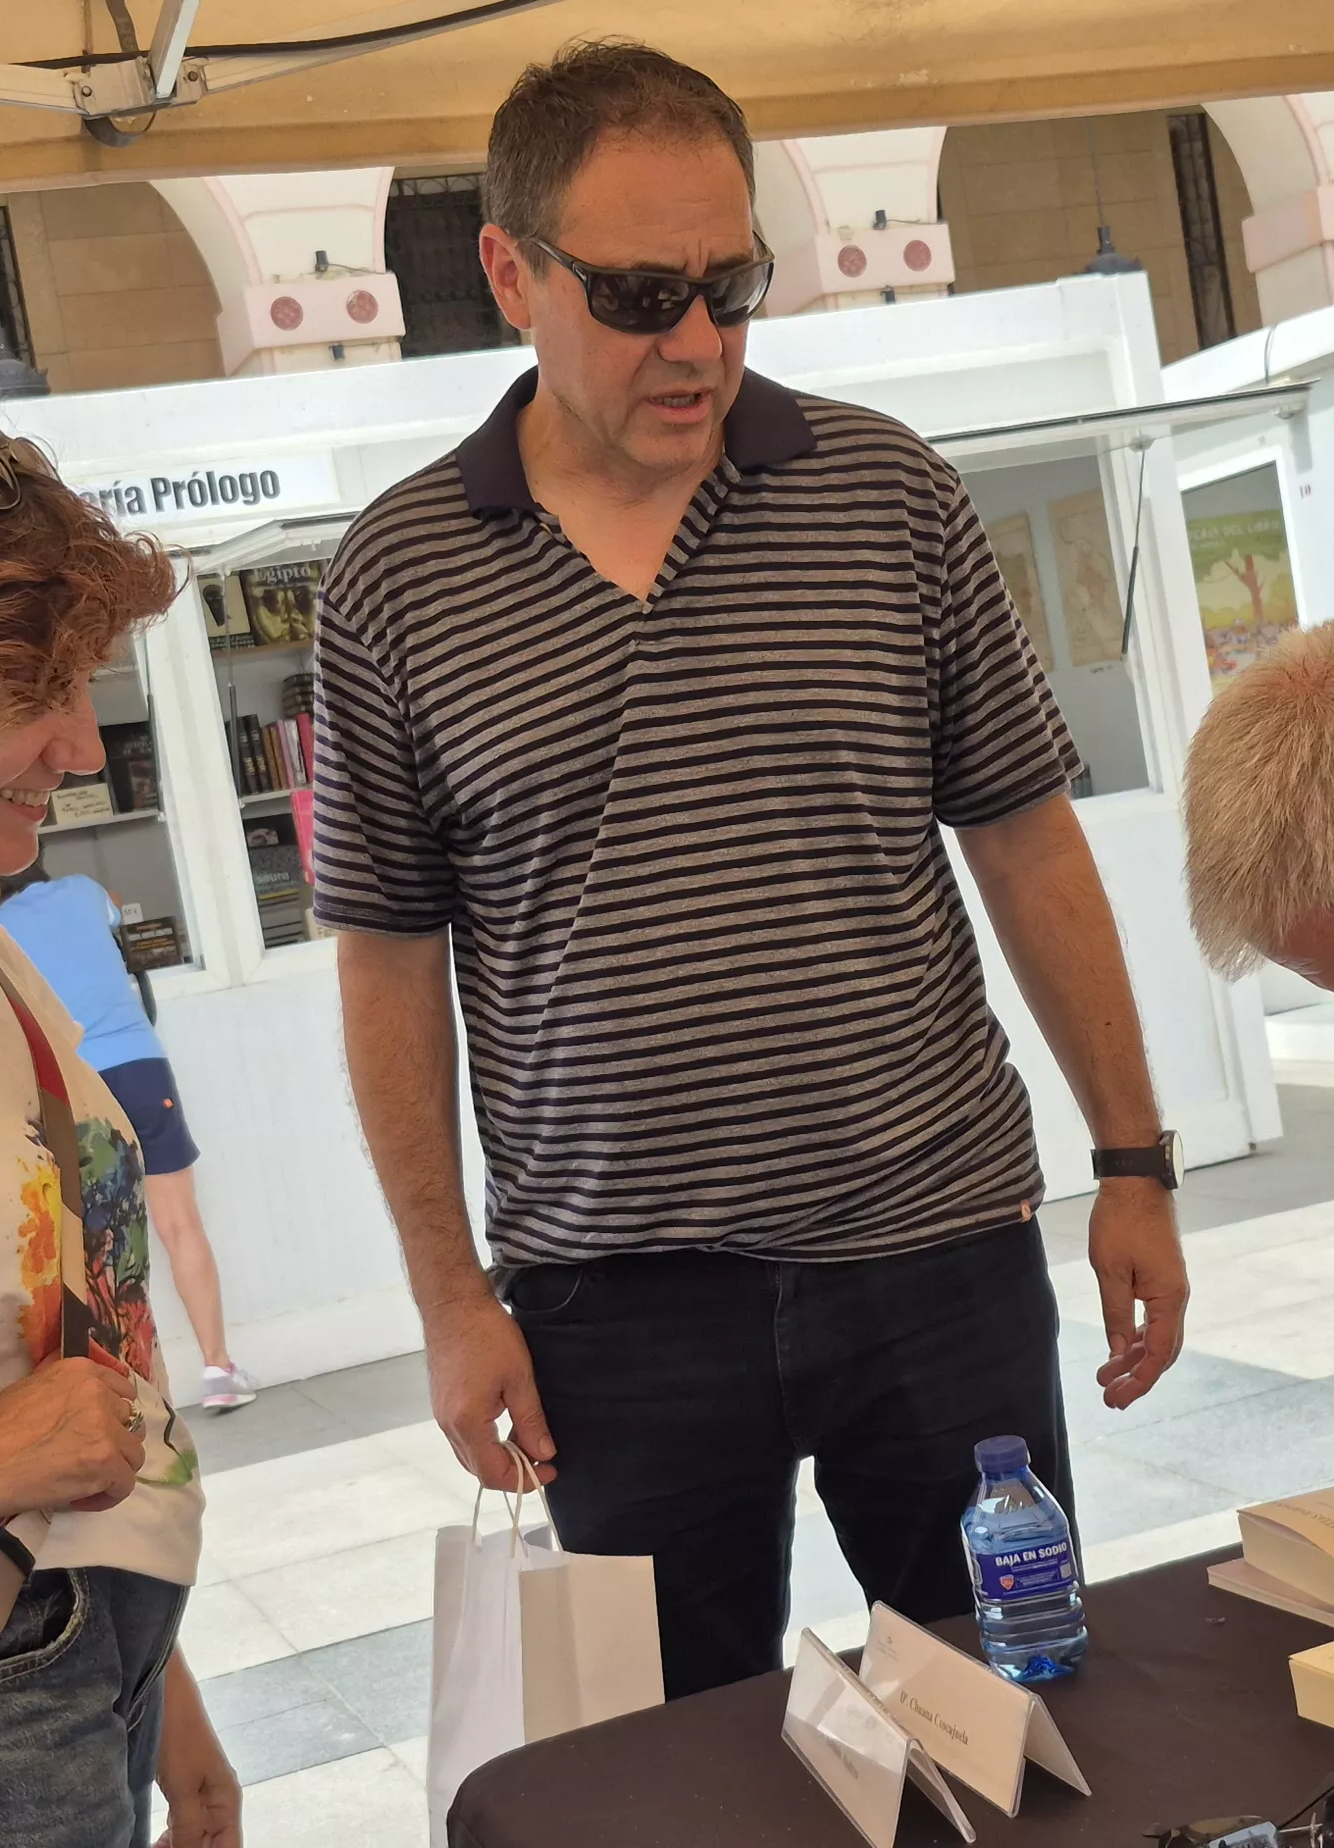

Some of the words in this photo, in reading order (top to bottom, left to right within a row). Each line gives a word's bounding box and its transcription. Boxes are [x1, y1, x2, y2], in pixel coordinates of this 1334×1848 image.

[150, 470, 281, 513] Prólogo
[253, 564, 310, 584] Egipto
[995, 1553, 1021, 1567] BAJA
[1022, 1550, 1037, 1562] EN
[1038, 1541, 1067, 1559] SODIO
[910, 1697, 933, 1722] Chuana
[934, 1712, 969, 1745] Coscujuela
